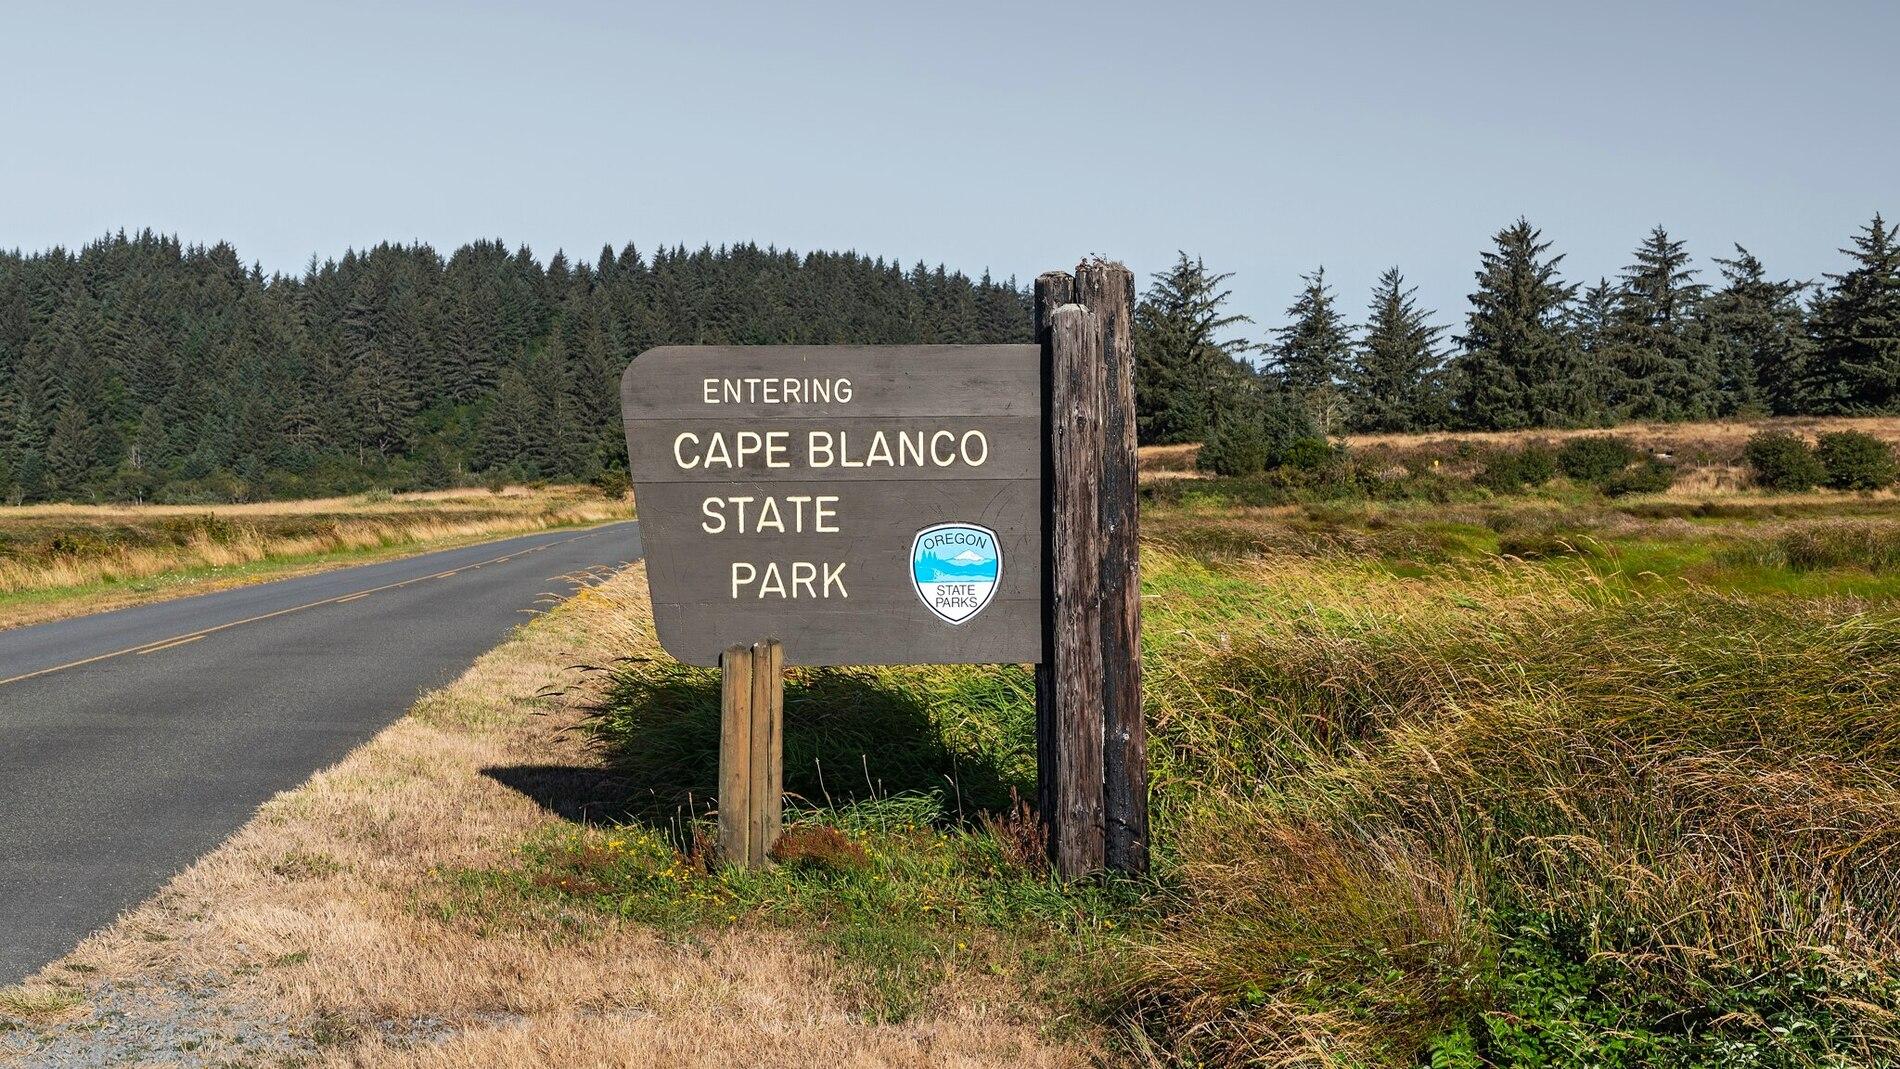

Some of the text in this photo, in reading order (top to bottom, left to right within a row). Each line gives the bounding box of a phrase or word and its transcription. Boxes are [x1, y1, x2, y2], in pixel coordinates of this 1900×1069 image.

[702, 377, 854, 405] ENTERING
[673, 429, 989, 470] CAPE BLANCO
[701, 495, 840, 534] STATE
[923, 532, 988, 550] OREGON
[731, 561, 849, 599] PARK
[936, 584, 976, 596] STATE
[935, 597, 978, 608] PARKS
